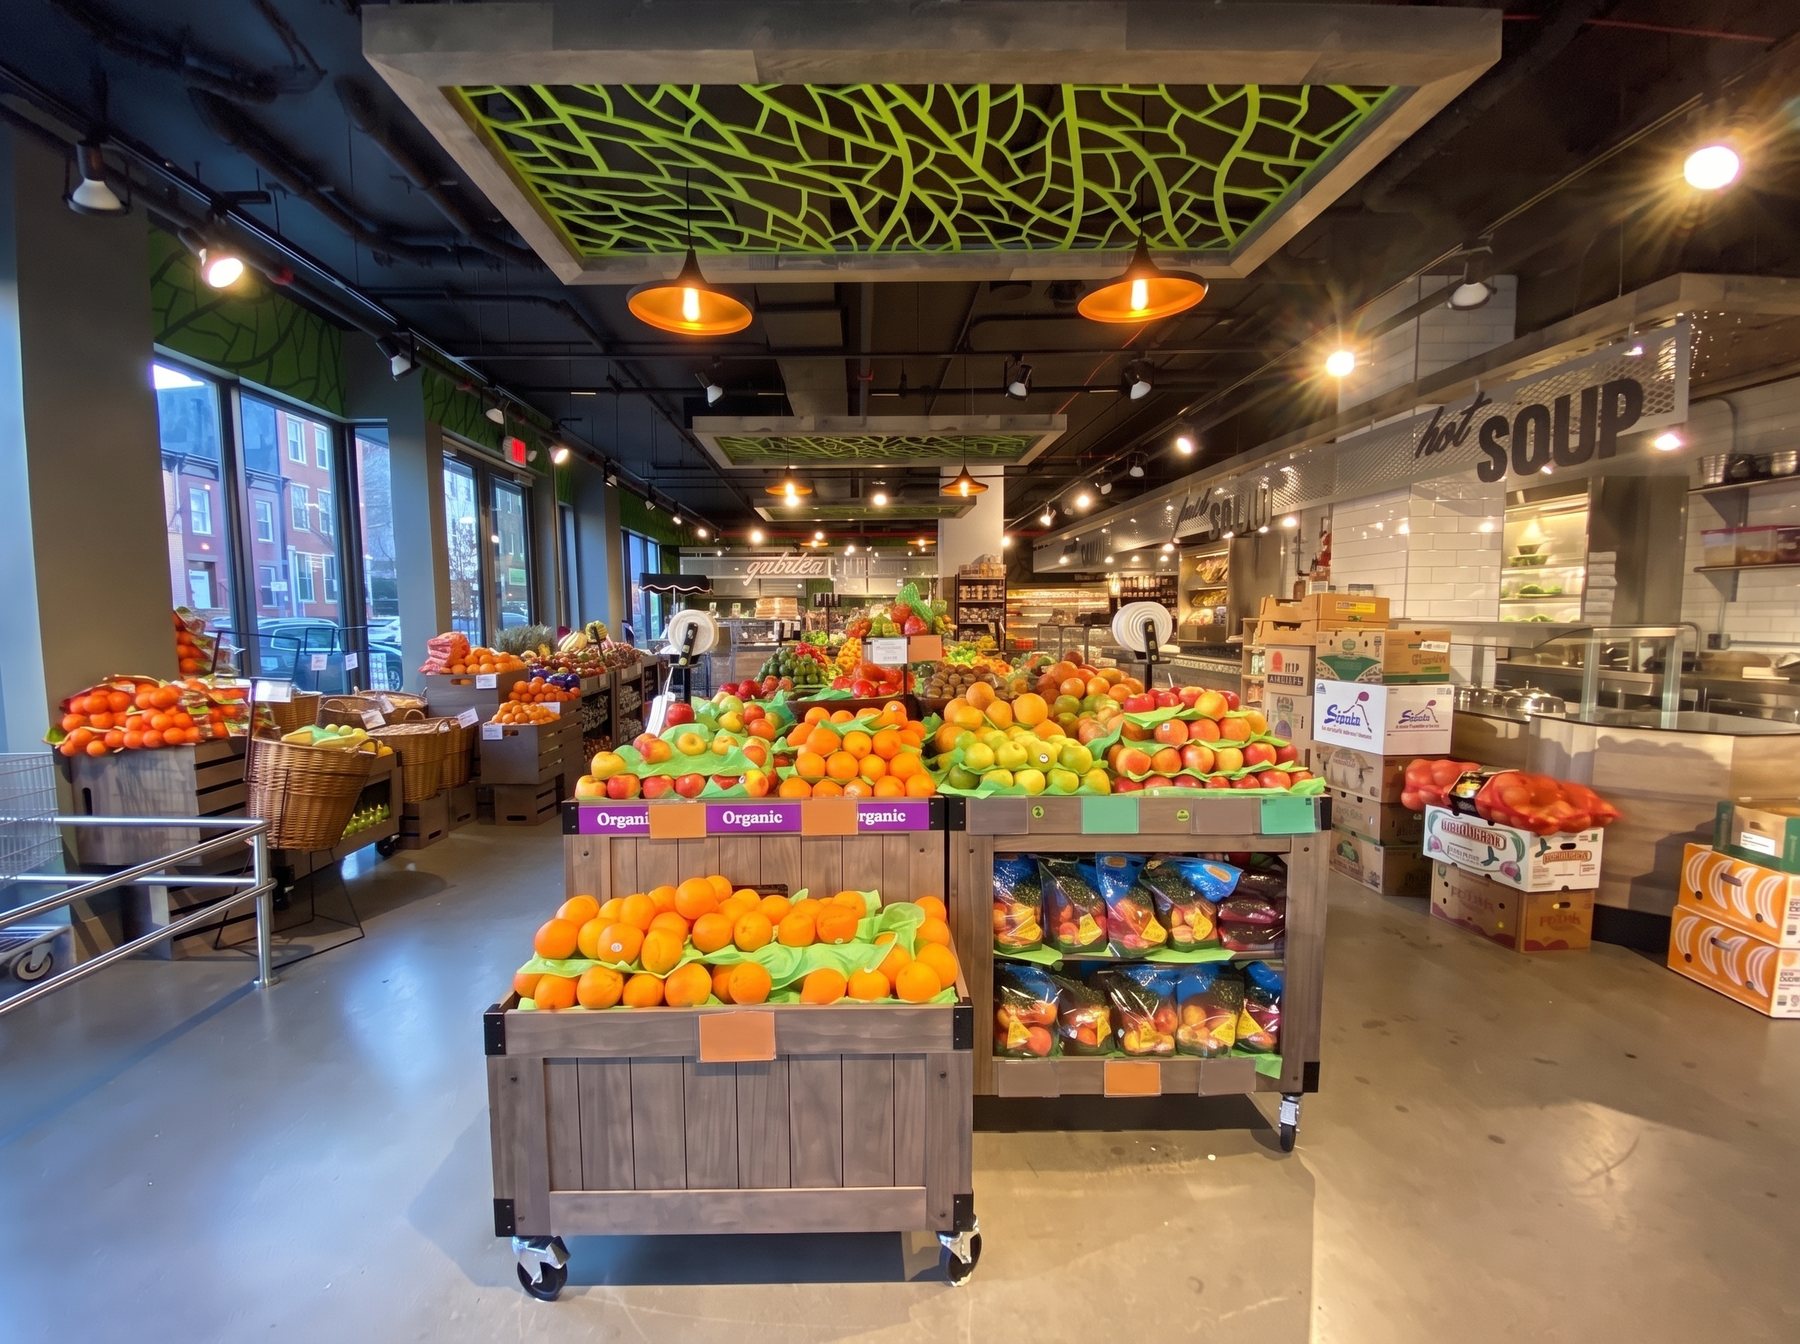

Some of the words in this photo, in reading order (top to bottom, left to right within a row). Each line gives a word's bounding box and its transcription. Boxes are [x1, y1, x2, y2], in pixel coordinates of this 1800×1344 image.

[1415, 391, 1492, 459] hot
[1477, 377, 1644, 483] SOUP
[596, 811, 650, 829] Organi
[722, 810, 783, 828] Organic
[856, 808, 906, 826] rganic
